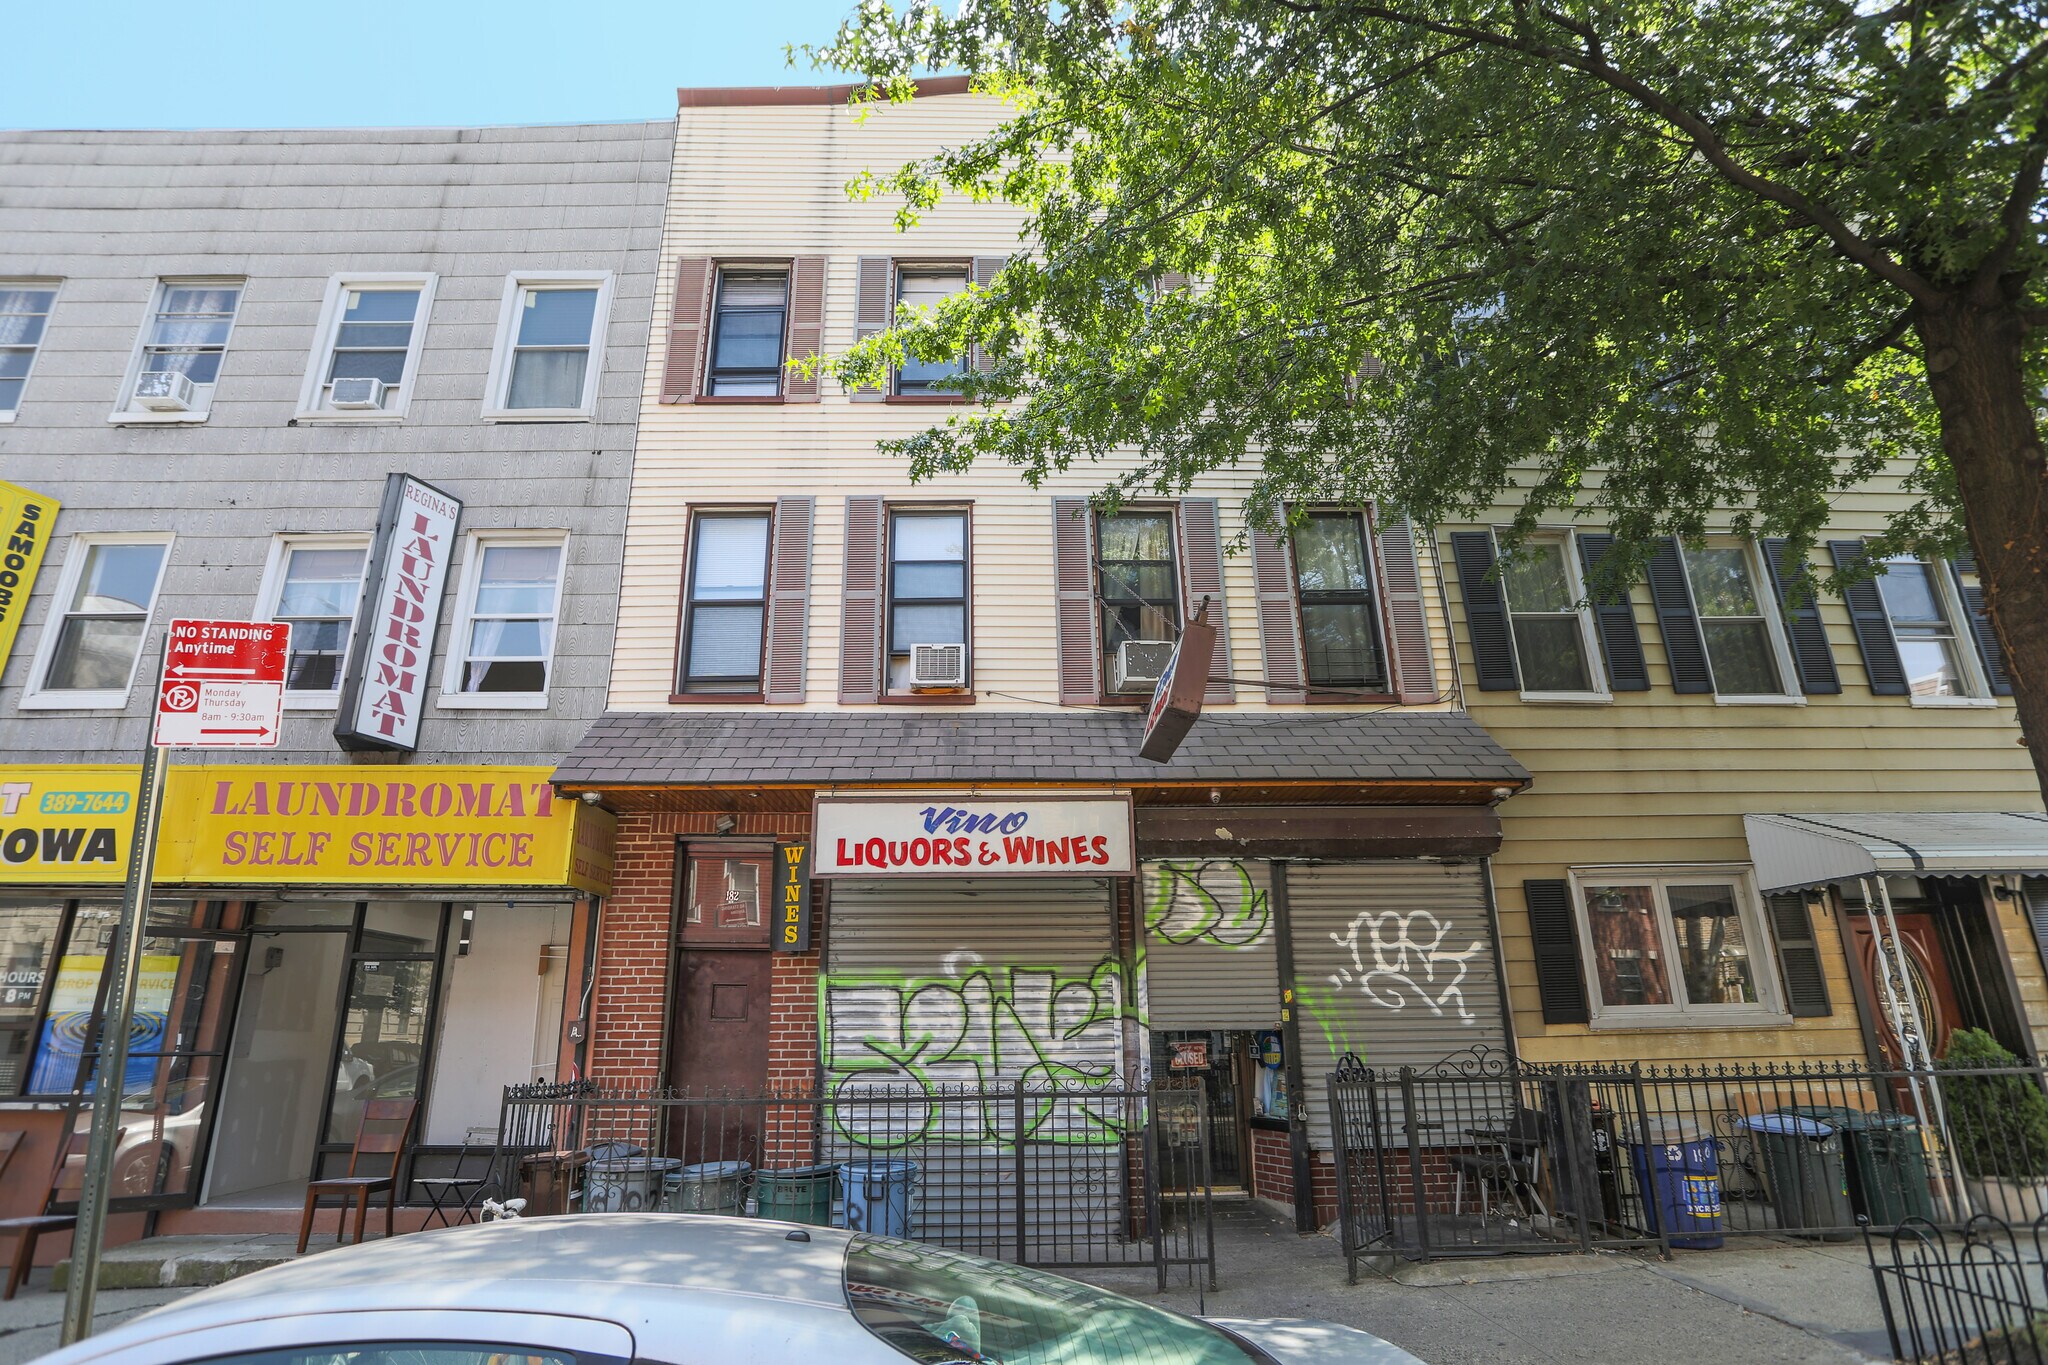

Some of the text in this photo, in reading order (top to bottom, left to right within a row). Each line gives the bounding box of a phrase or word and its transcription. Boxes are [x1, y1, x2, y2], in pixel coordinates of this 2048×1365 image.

[405, 483, 457, 520] REGINA'S
[176, 626, 273, 641] NO STANDING
[372, 511, 439, 738] LAUNDROMAT
[174, 641, 235, 656] Anytime
[205, 688, 241, 698] Monday
[204, 698, 246, 708] Thursday
[202, 713, 221, 721] 8am
[230, 713, 265, 721] 9:30am
[43, 793, 125, 812] 389-7644
[210, 781, 554, 818] LAUNDROMAT
[919, 805, 1029, 836] Vino
[0, 827, 117, 864] OWA
[222, 830, 332, 867] SELF
[348, 831, 535, 867] SERVICE
[836, 835, 1110, 870] LIQUORS & WINES
[784, 846, 805, 944] WINES
[0, 971, 45, 984] HOURS
[57, 978, 175, 989] DROP RVICE
[5, 988, 17, 1003] 8
[18, 992, 31, 1000] PM
